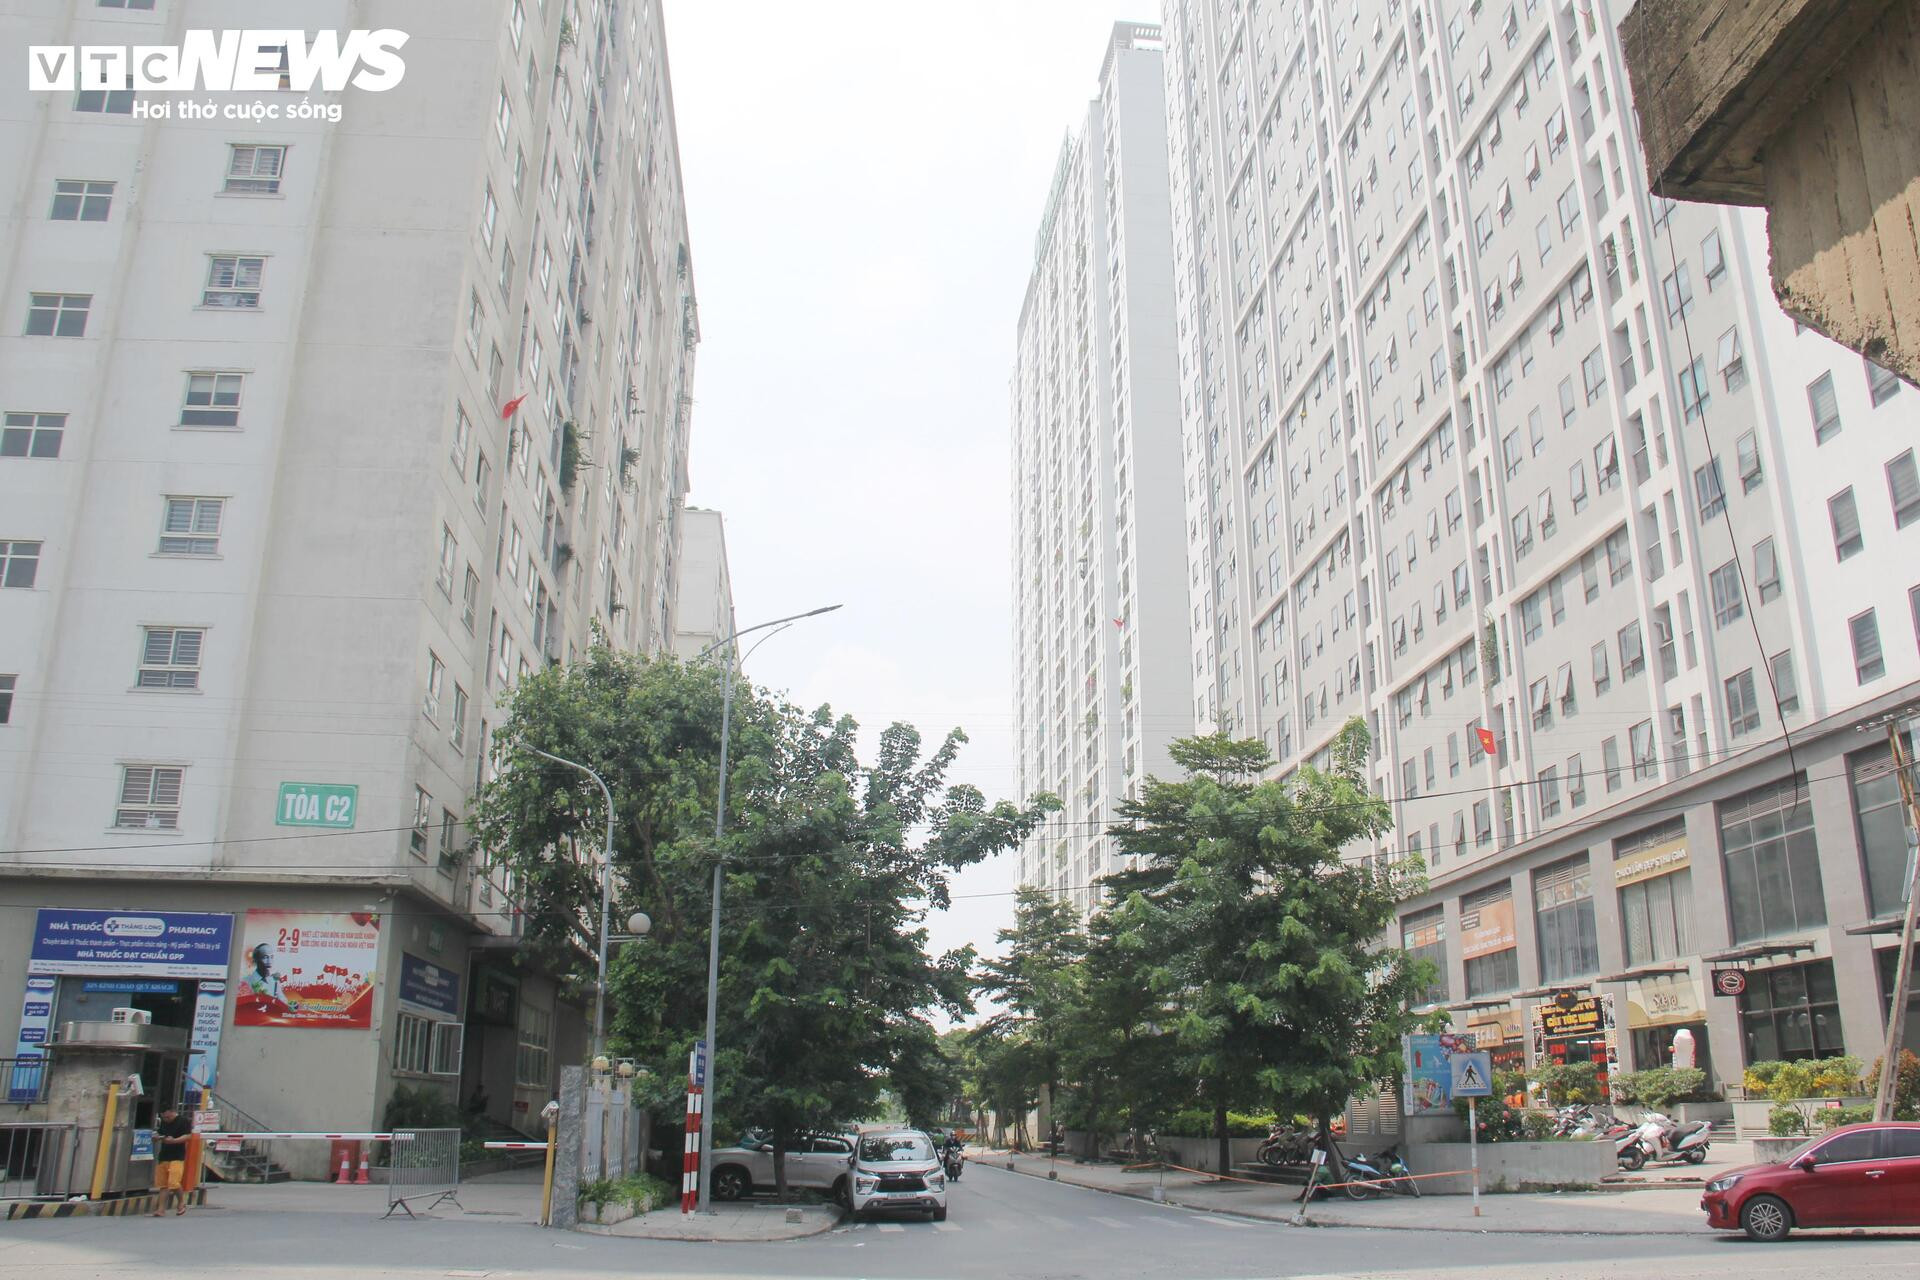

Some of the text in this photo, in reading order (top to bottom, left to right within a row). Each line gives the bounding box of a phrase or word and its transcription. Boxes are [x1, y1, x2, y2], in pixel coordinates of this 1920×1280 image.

[325, 795, 351, 821] C2
[49, 921, 103, 931] NHÀ THUỐC
[168, 925, 217, 935] PHARMACY
[77, 950, 94, 958] NHÀ
[96, 950, 122, 959] THUỐC
[124, 952, 139, 960] ĐẠT
[140, 950, 168, 960] CHUẨN
